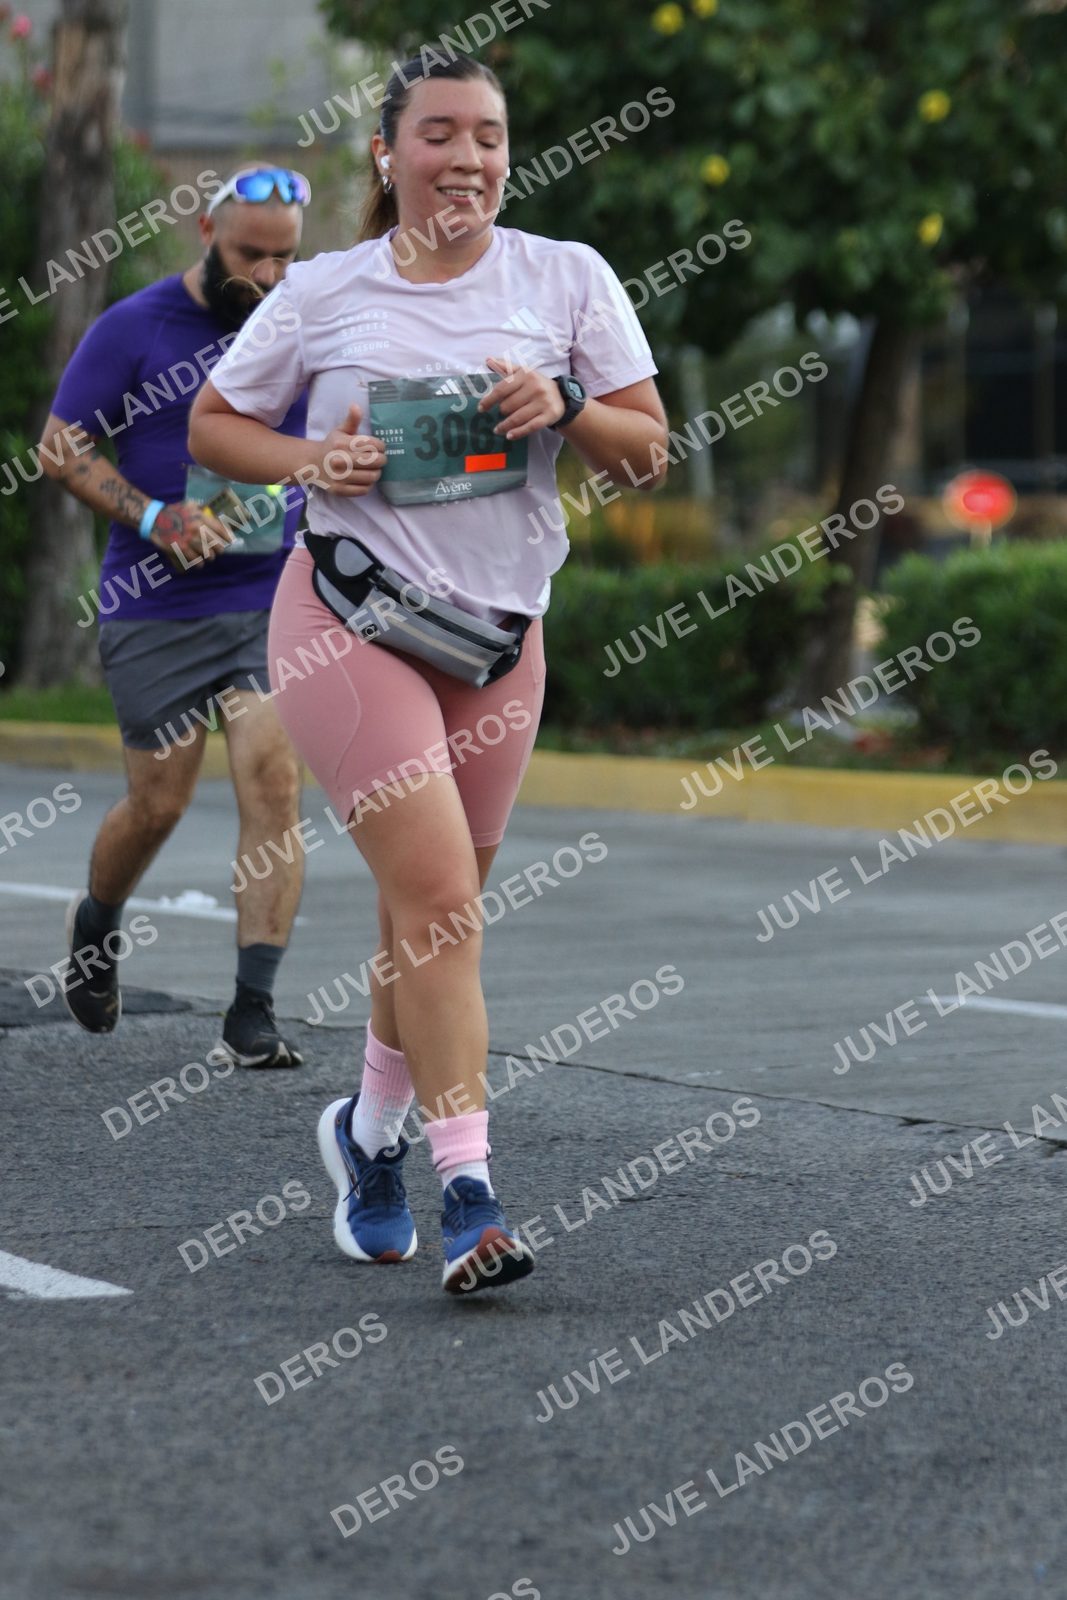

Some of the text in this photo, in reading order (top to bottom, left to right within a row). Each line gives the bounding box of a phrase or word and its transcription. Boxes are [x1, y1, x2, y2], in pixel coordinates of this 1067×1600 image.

[341, 322, 388, 337] SPLITS
[341, 341, 390, 357] SAMSUNG
[435, 481, 472, 494] Avène
